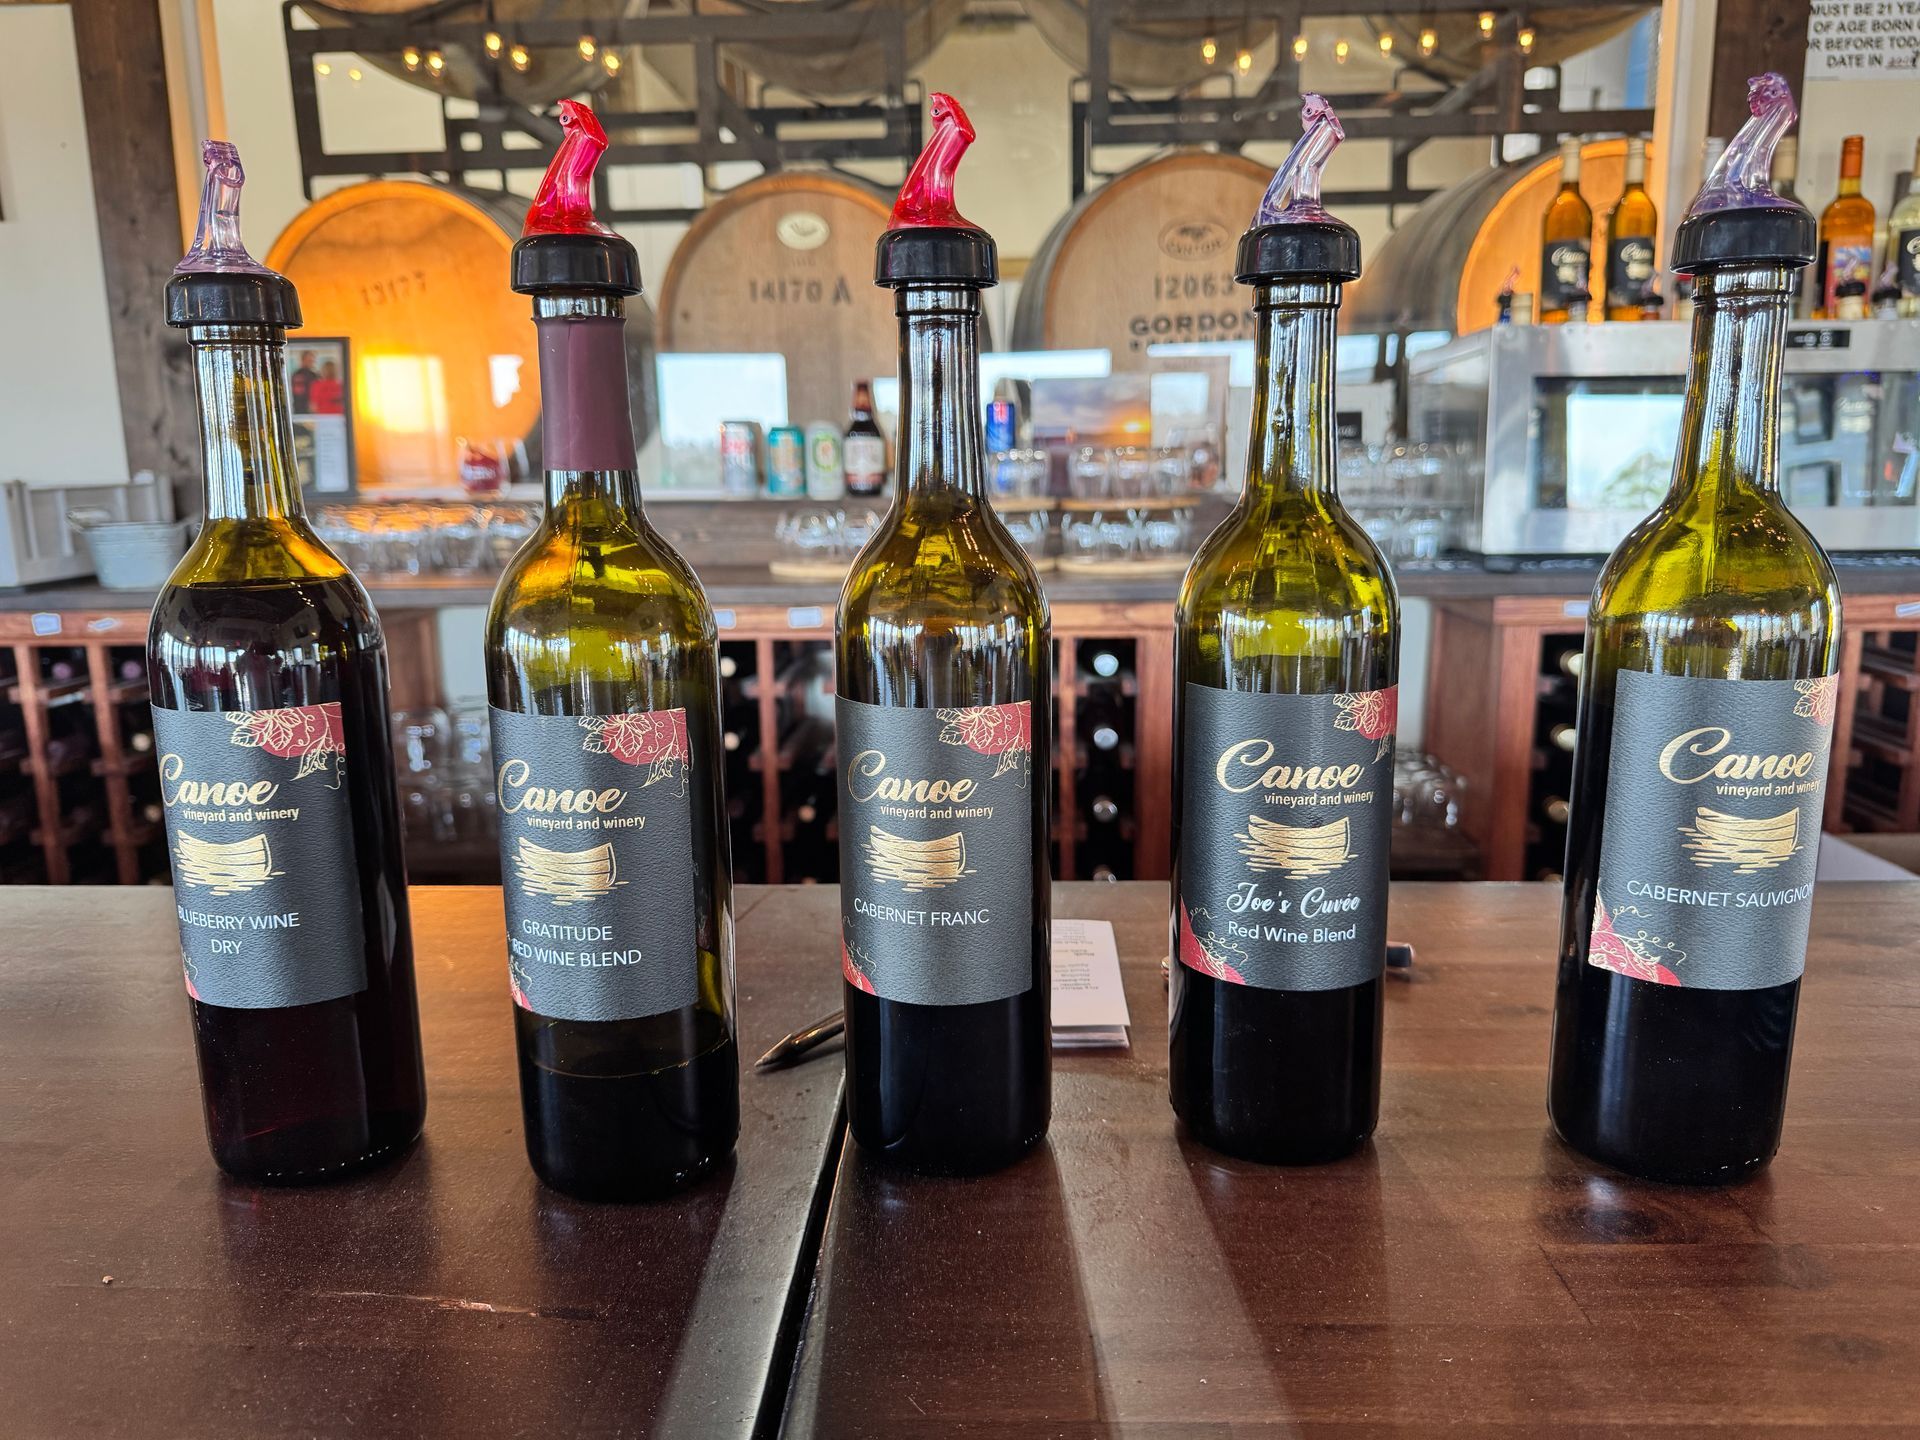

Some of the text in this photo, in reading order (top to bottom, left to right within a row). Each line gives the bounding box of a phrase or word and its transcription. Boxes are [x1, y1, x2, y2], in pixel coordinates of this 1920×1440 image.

[1810, 3, 1849, 16] MUST
[1853, 2, 1873, 15] BE
[1877, 3, 1892, 15] 21
[1813, 20, 1832, 33] OF
[1836, 20, 1867, 33] AGE
[1871, 19, 1914, 32] BORN
[1825, 36, 1883, 50] BEFORE
[1826, 54, 1865, 68] DATE
[1868, 54, 1883, 67] IN
[749, 273, 852, 305] 14170 A
[1216, 739, 1365, 793] Canoe
[1659, 727, 1815, 784] Canoe
[159, 753, 279, 807] Canoe
[498, 759, 627, 813] Canoe
[847, 750, 979, 803] Canoe
[1264, 791, 1373, 809] vineyard and winery
[1716, 779, 1821, 800] vineyard and winery
[183, 808, 300, 823] vineyard and winery
[527, 815, 646, 831] vineyard and winery
[880, 805, 994, 820] vineyard and winery
[1226, 882, 1361, 918] Joe's Cuvée
[1626, 880, 1732, 907] CABERNET
[249, 912, 300, 930] WINE
[854, 897, 990, 927] CABERNET FRANC
[522, 919, 613, 942] GRATITUDE
[1228, 921, 1356, 943] Red Wine Blend
[211, 938, 243, 954] DRY
[511, 937, 642, 967] RED WINE BLEND
